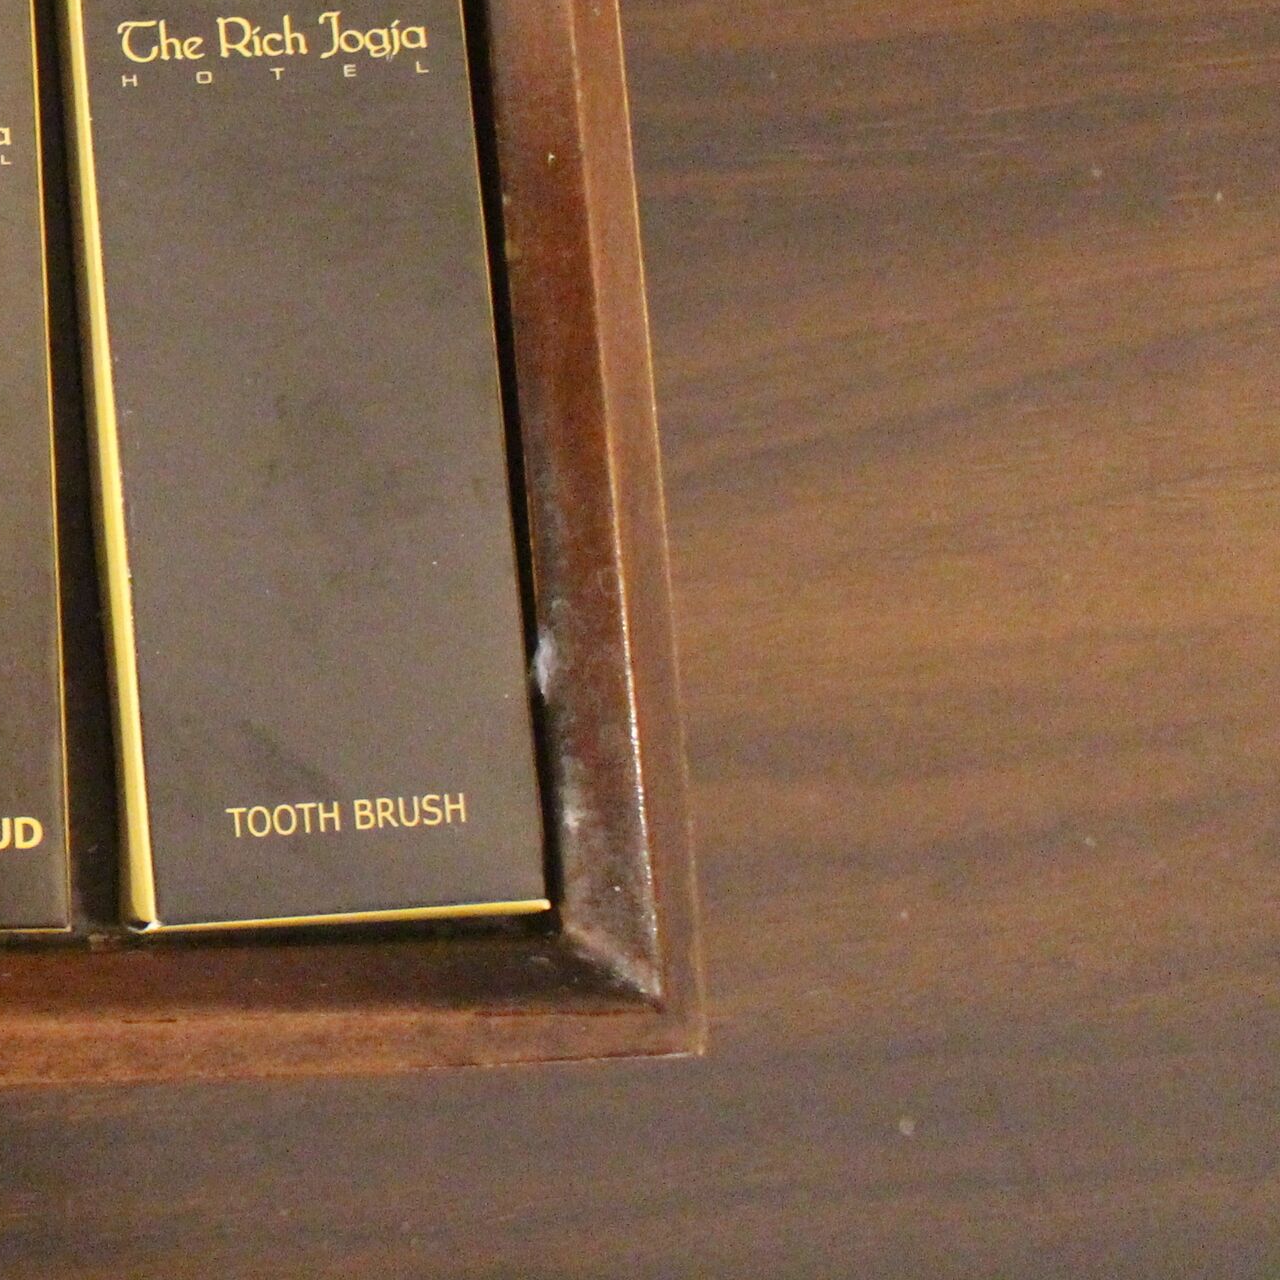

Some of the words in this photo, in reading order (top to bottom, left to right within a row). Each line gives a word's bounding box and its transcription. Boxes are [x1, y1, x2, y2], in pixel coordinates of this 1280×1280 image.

[116, 18, 206, 63] The
[215, 14, 309, 59] Rich
[318, 10, 429, 61] Jogja
[224, 801, 341, 838] TOOTH
[352, 792, 468, 830] BRUSH
